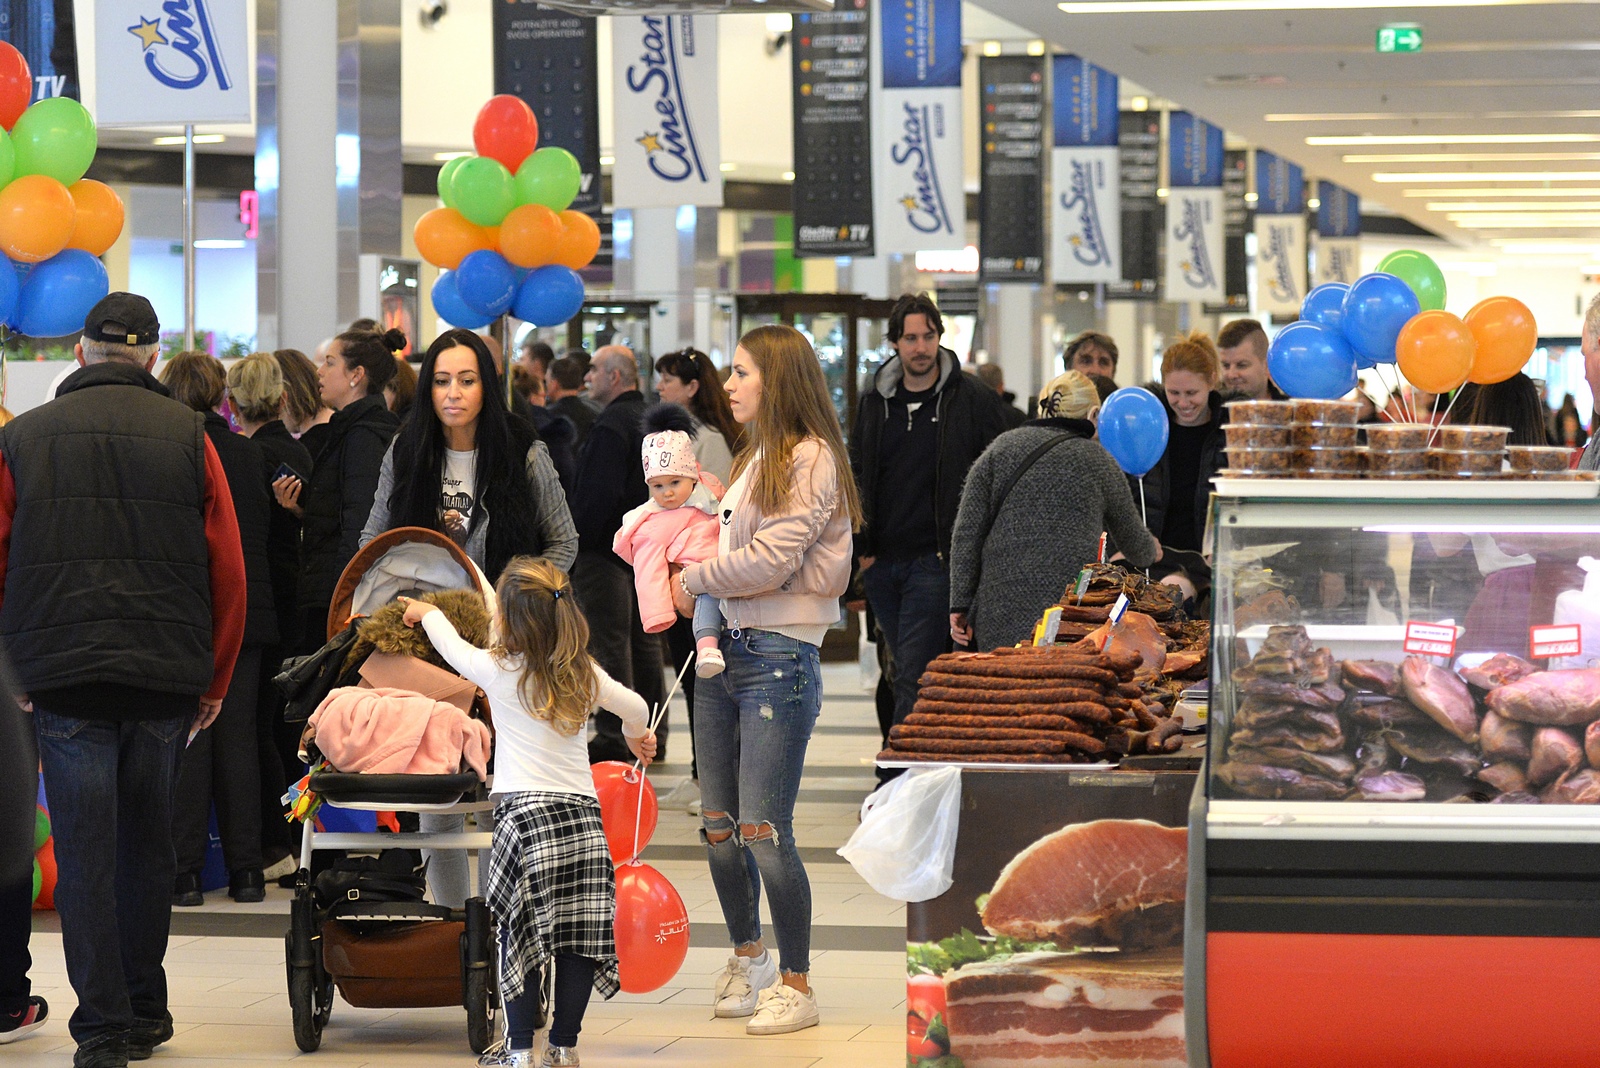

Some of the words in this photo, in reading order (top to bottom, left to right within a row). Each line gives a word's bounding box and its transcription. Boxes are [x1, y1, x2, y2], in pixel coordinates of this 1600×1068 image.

[35, 75, 67, 100] TV
[890, 101, 943, 234] CineStar
[850, 224, 870, 241] TV
